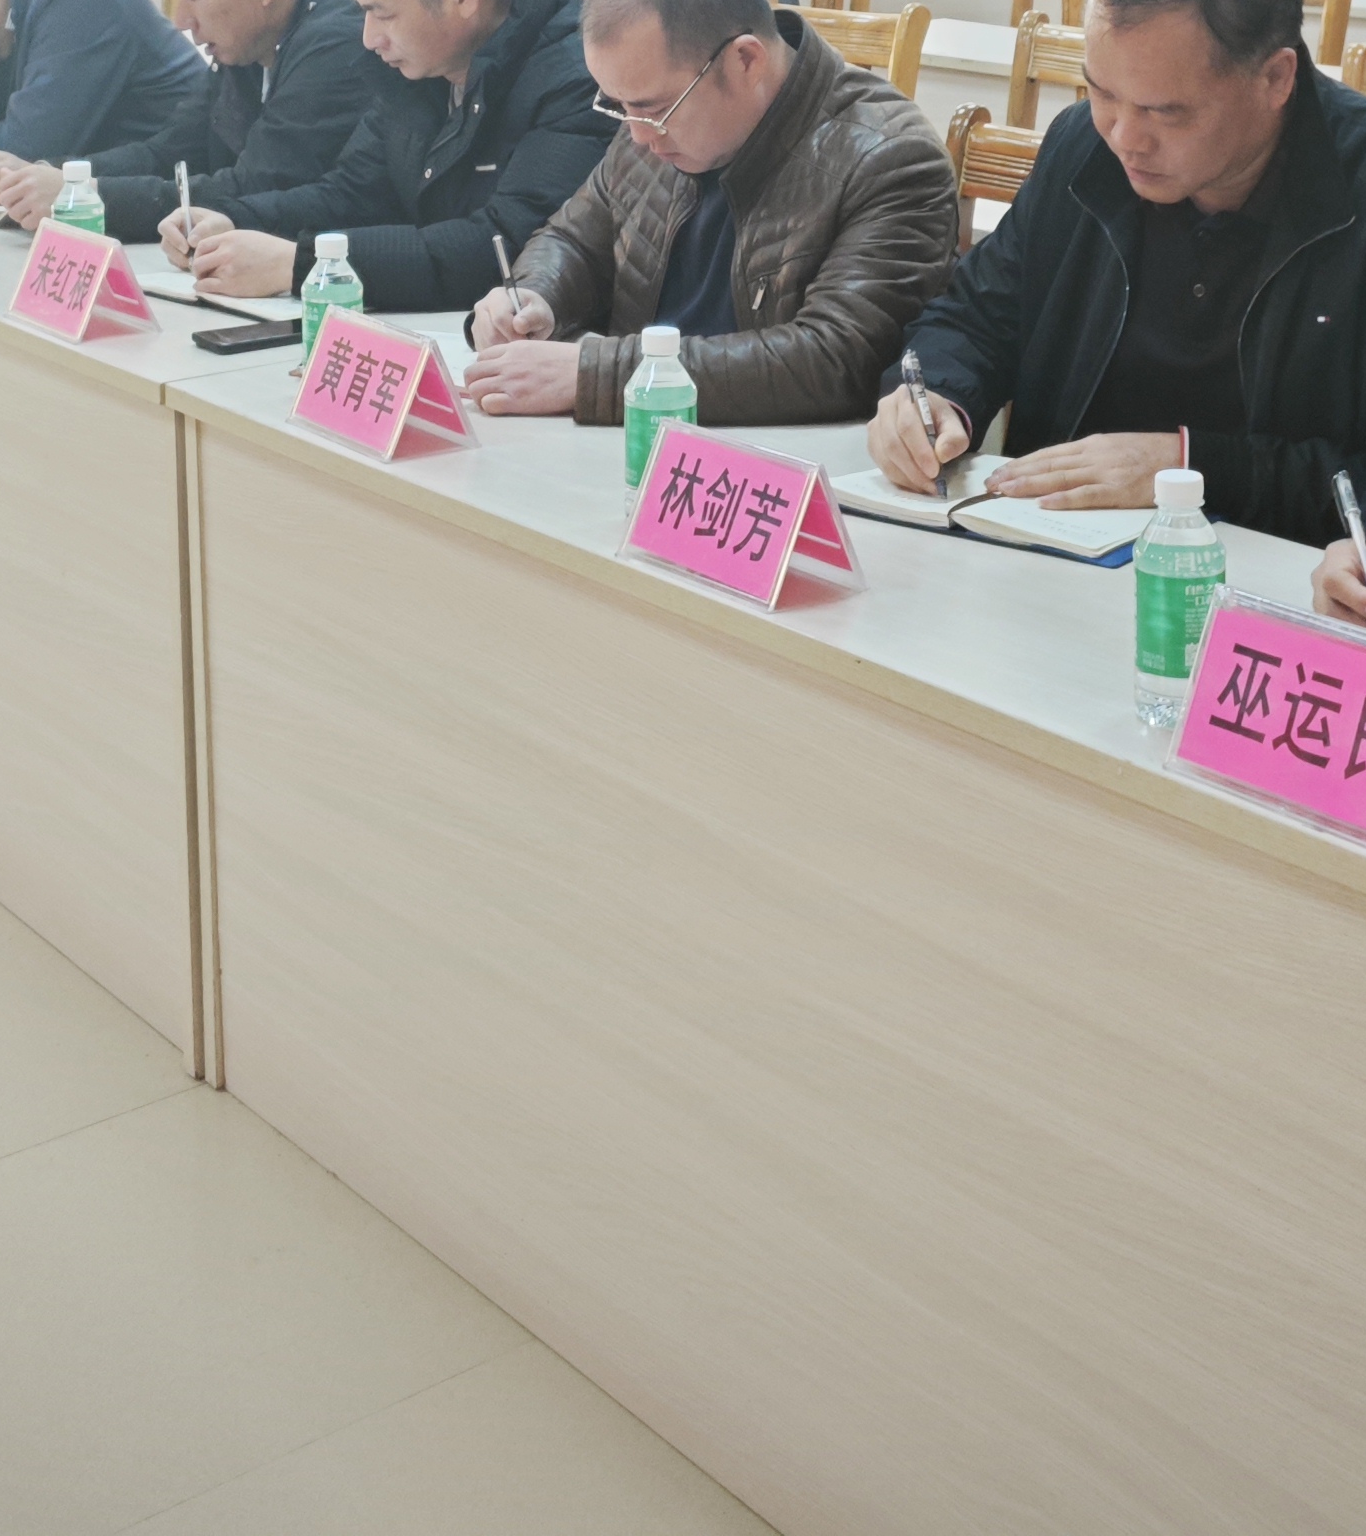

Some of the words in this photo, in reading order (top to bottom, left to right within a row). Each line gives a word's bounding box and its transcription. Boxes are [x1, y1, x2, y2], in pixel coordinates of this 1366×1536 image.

[29, 245, 97, 313] 朱红根
[314, 335, 409, 424] 黄育军
[657, 451, 791, 563] 林剑芳
